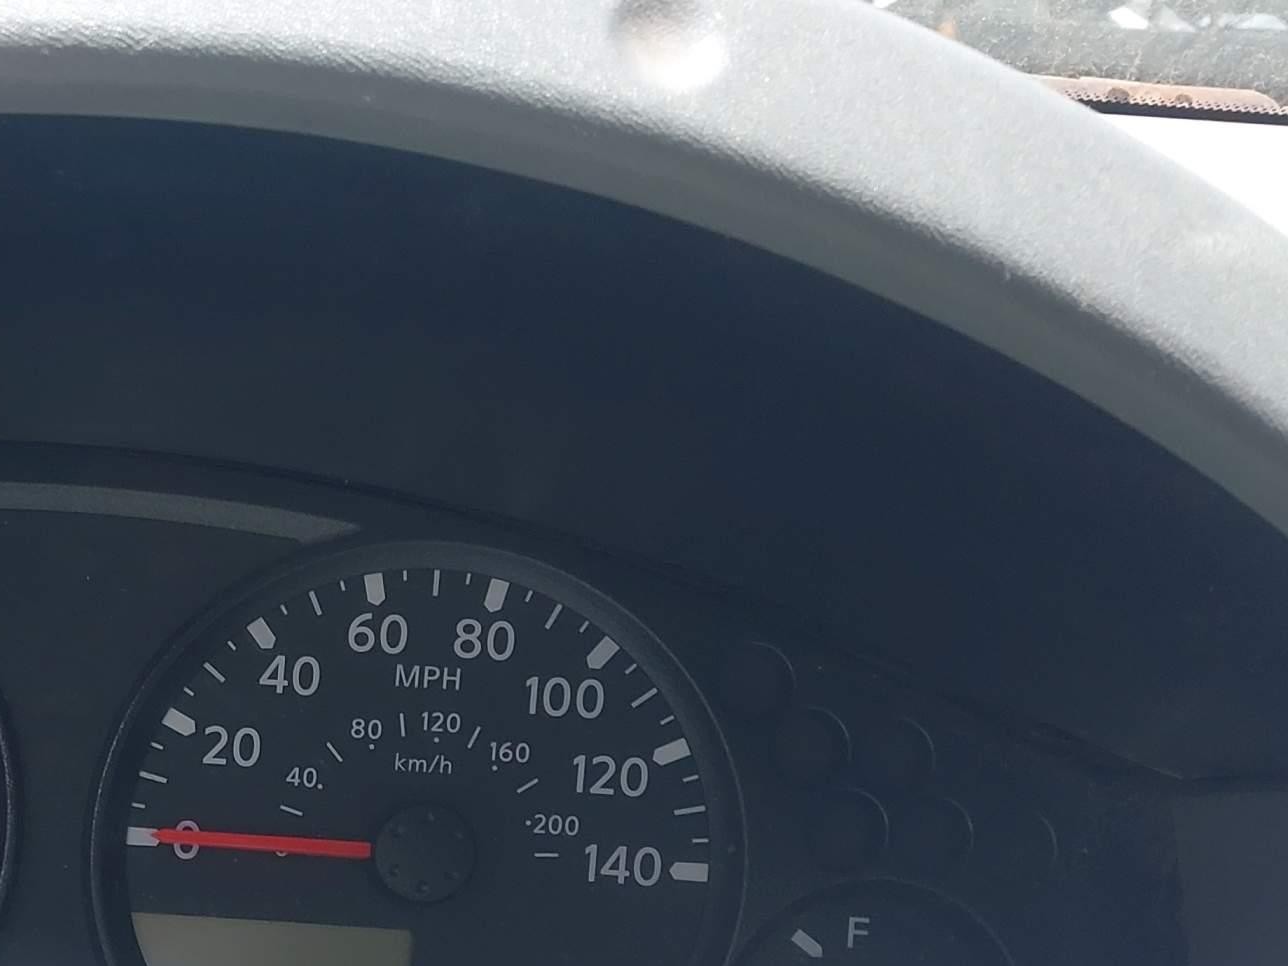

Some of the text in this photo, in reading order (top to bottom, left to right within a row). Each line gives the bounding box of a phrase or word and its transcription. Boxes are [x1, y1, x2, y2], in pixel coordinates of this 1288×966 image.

[347, 613, 409, 656] 60
[453, 618, 516, 661] 80
[259, 655, 321, 696] 40
[394, 663, 461, 691] MPH
[525, 676, 605, 719] 100
[350, 718, 383, 741] 80
[421, 711, 461, 734] 120
[203, 726, 261, 767] 20
[394, 753, 453, 776] km/h
[490, 741, 530, 764] 160
[572, 755, 649, 797] 120
[173, 820, 200, 860] 0
[533, 814, 579, 836] 200
[584, 844, 662, 887] 140
[847, 917, 870, 949] F
